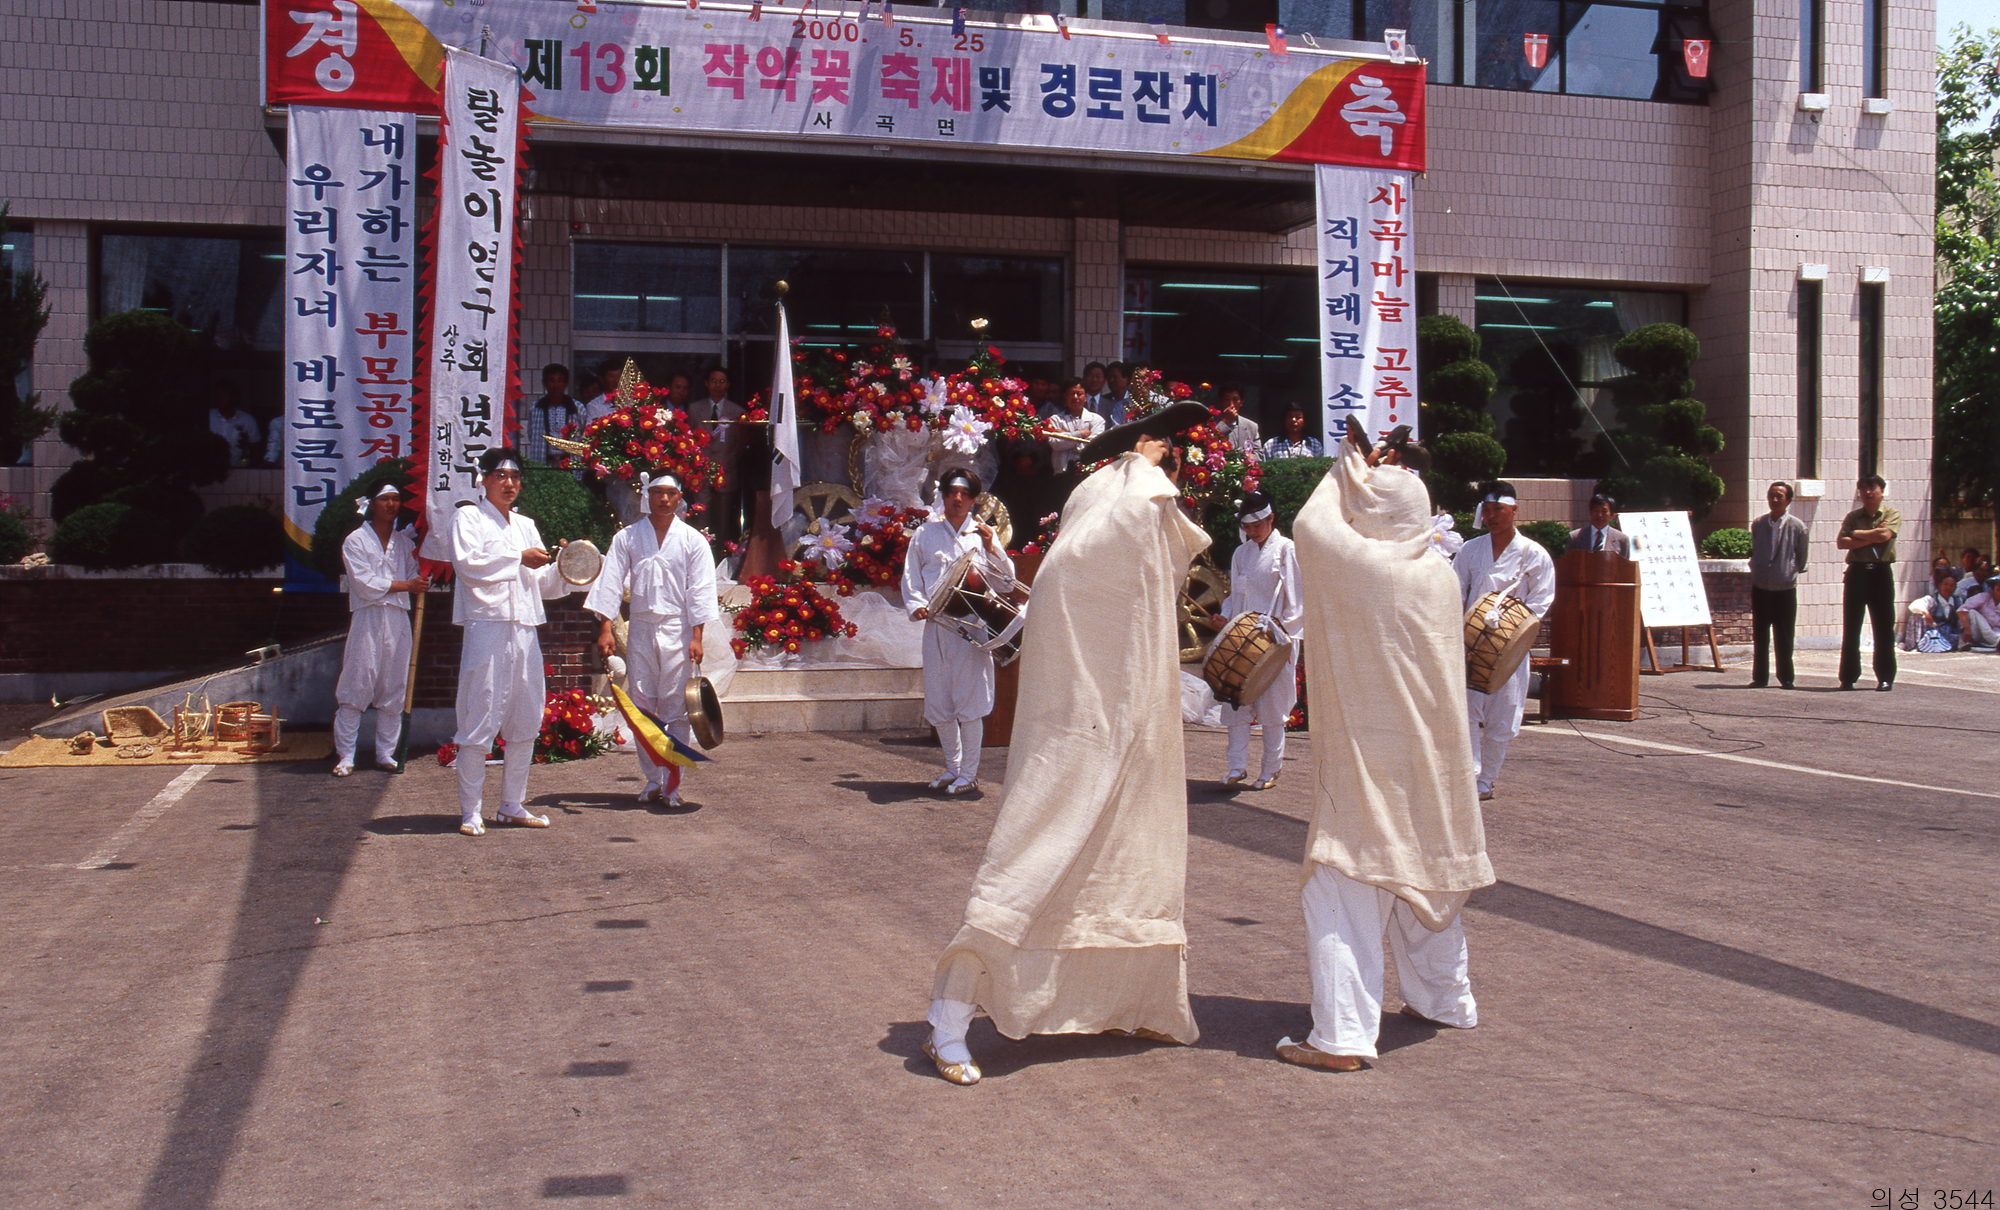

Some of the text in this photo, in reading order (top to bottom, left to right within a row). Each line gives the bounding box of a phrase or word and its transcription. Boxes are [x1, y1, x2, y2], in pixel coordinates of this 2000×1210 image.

[286, 1, 357, 92] 경
[523, 38, 671, 97] 제13회
[702, 43, 851, 106] 작약꽃
[1039, 63, 1218, 127] 경로잔치
[953, 33, 985, 52] 25
[1339, 75, 1407, 156] 축
[291, 163, 345, 328] 우리자녀
[355, 122, 410, 283] 내가하는
[1368, 182, 1410, 323] 사곡마늘
[1324, 216, 1365, 359] 직거래로
